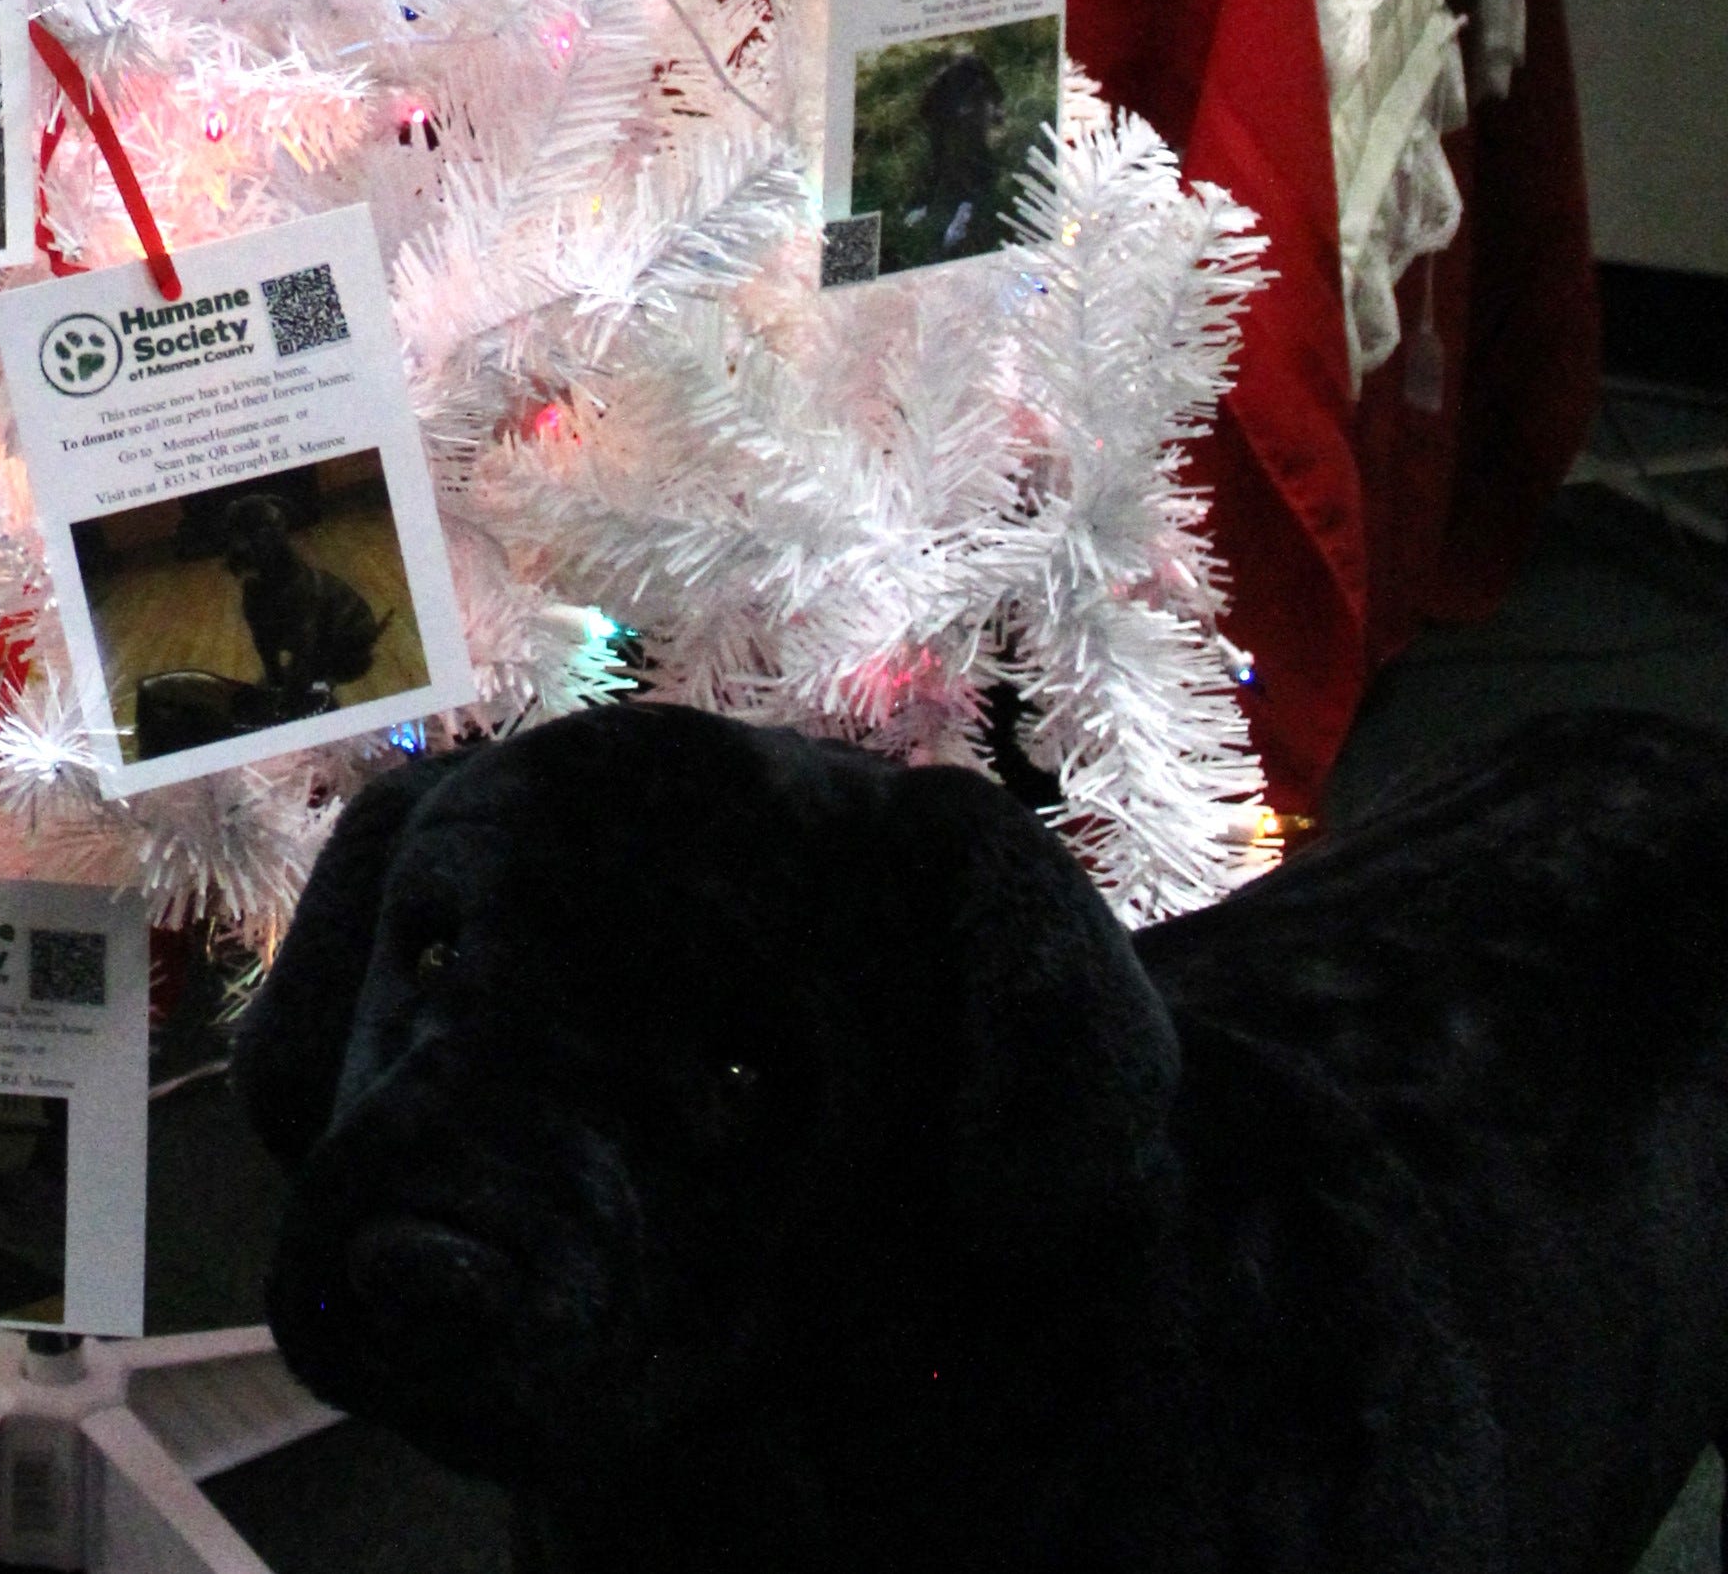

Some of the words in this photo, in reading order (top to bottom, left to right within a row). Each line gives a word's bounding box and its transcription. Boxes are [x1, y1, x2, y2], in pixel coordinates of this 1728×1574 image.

[118, 287, 250, 335] Humane
[128, 367, 144, 382] of
[145, 356, 201, 377] Monroe
[203, 343, 254, 363] County
[131, 317, 248, 363] Society
